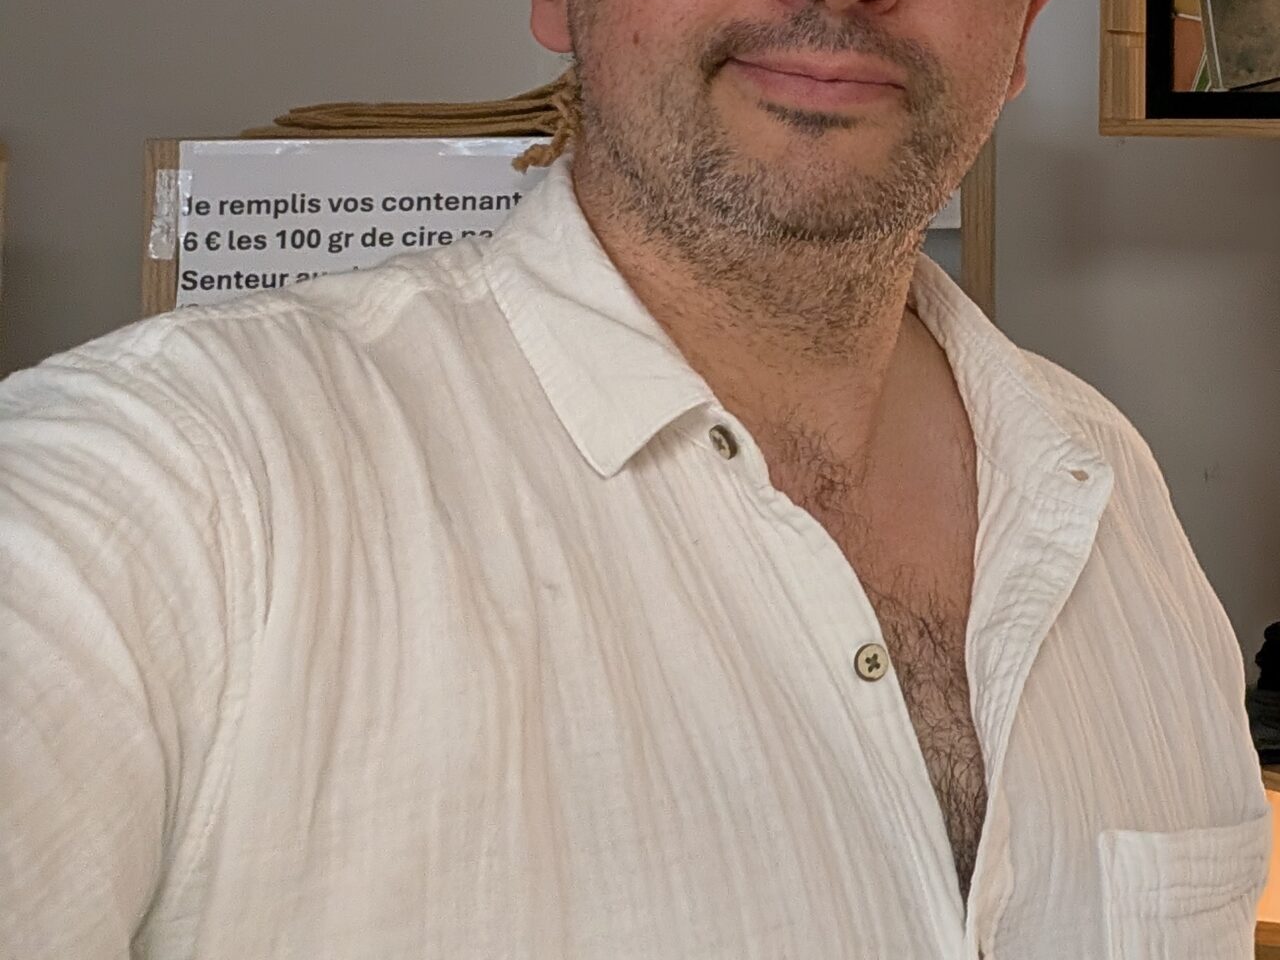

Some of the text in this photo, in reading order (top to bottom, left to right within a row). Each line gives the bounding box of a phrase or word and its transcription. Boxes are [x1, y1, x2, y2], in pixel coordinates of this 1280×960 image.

[182, 196, 211, 216] Je
[219, 193, 321, 219] remplis
[328, 197, 374, 213] vos
[183, 231, 198, 252] 6
[205, 230, 221, 251] €
[228, 230, 267, 250] les
[276, 228, 321, 249] 100
[328, 230, 355, 253] gr
[361, 226, 394, 248] de
[401, 224, 453, 246] cire
[181, 270, 289, 291] Senteur
